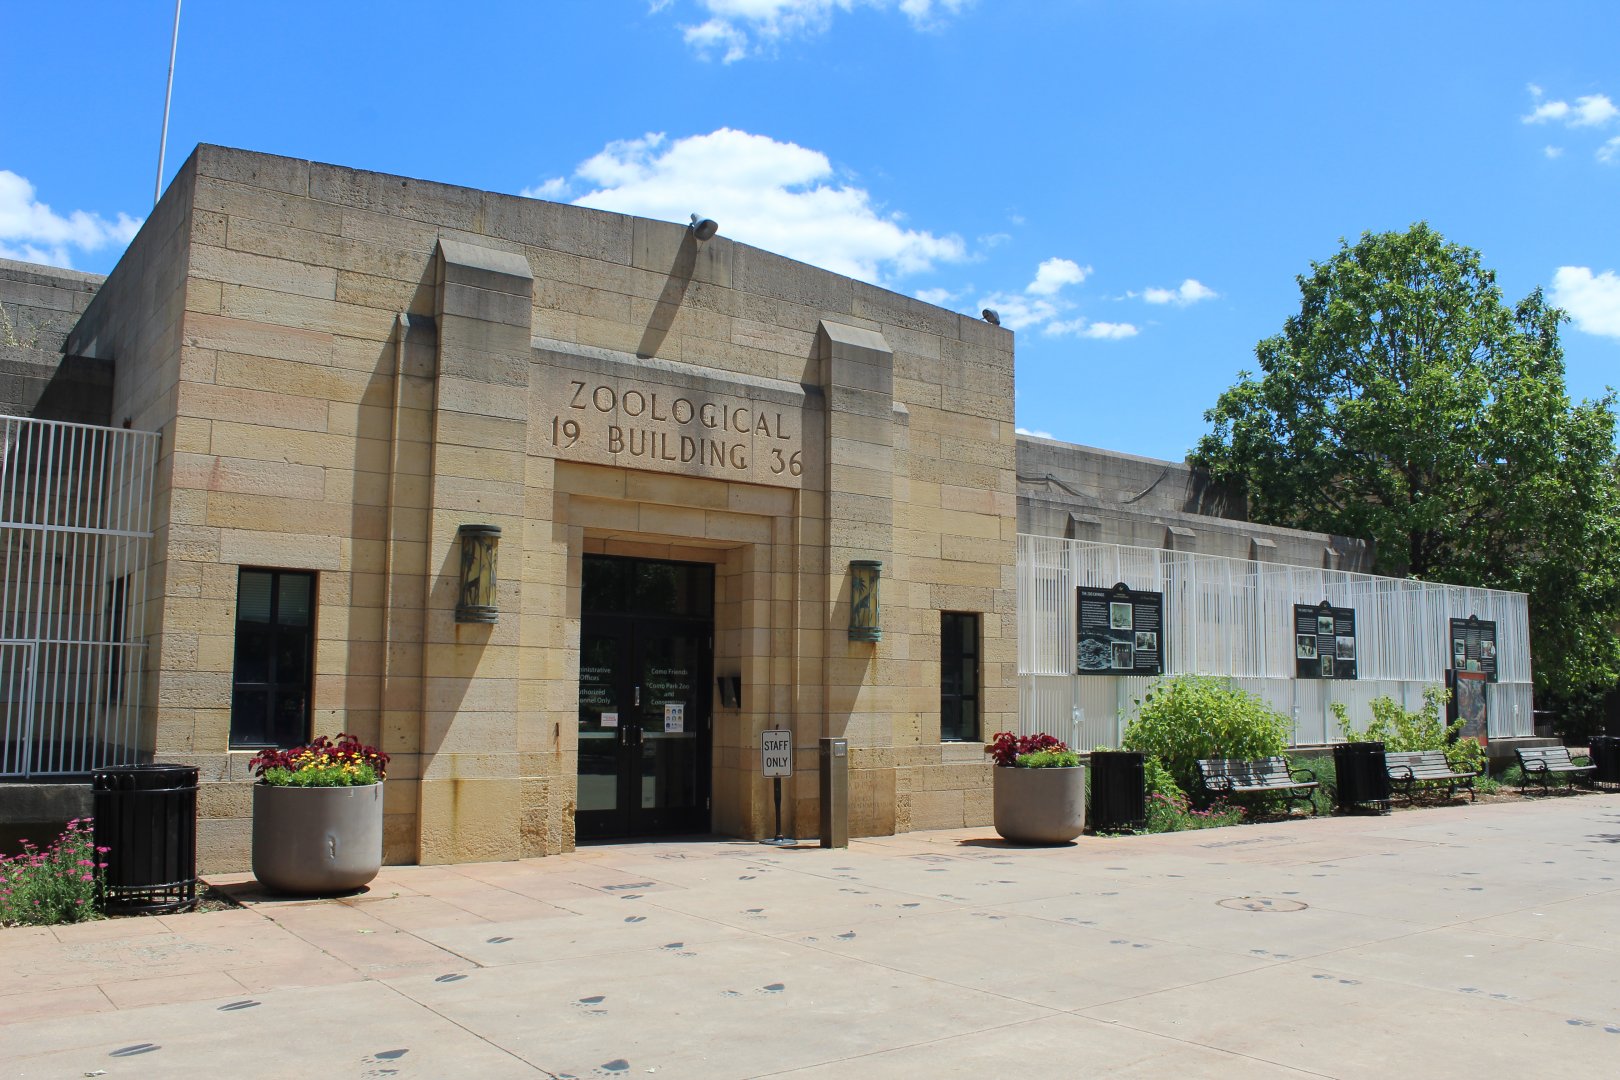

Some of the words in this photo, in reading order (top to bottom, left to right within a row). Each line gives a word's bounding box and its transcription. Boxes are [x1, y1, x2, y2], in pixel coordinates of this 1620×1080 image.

[568, 380, 791, 440] ZOOLOGICAL
[551, 415, 581, 449] 19
[607, 425, 748, 470] BUILDING
[770, 447, 804, 477] 36
[764, 740, 789, 751] STAFF
[766, 757, 788, 768] ONLY
